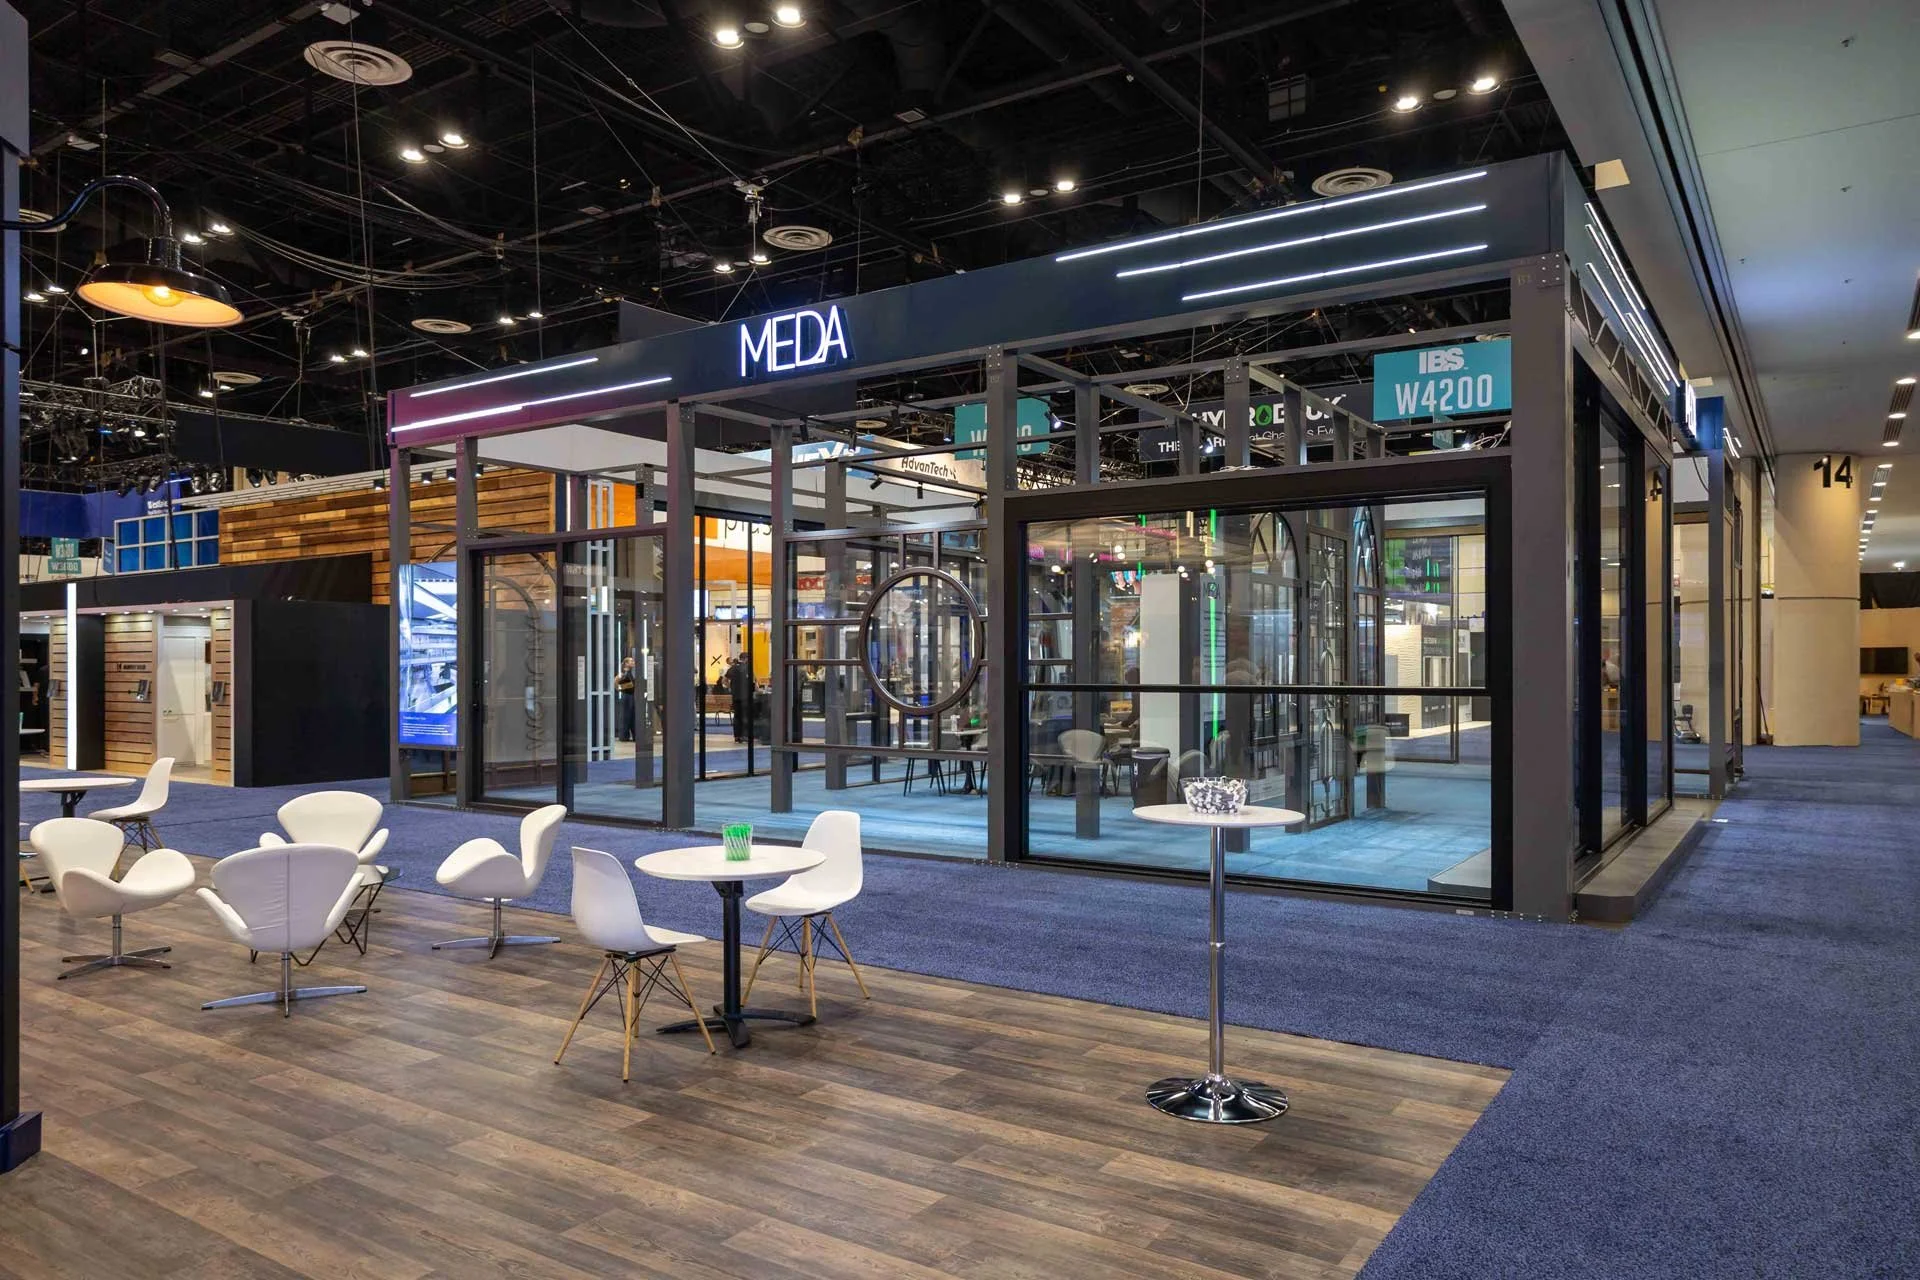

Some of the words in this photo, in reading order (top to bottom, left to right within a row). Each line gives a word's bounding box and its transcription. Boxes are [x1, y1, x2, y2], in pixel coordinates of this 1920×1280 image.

[741, 304, 848, 377] MEDA
[1418, 347, 1465, 374] IBS
[1395, 374, 1493, 415] W4200
[901, 456, 949, 478] AdvanTech
[1813, 454, 1853, 489] 14
